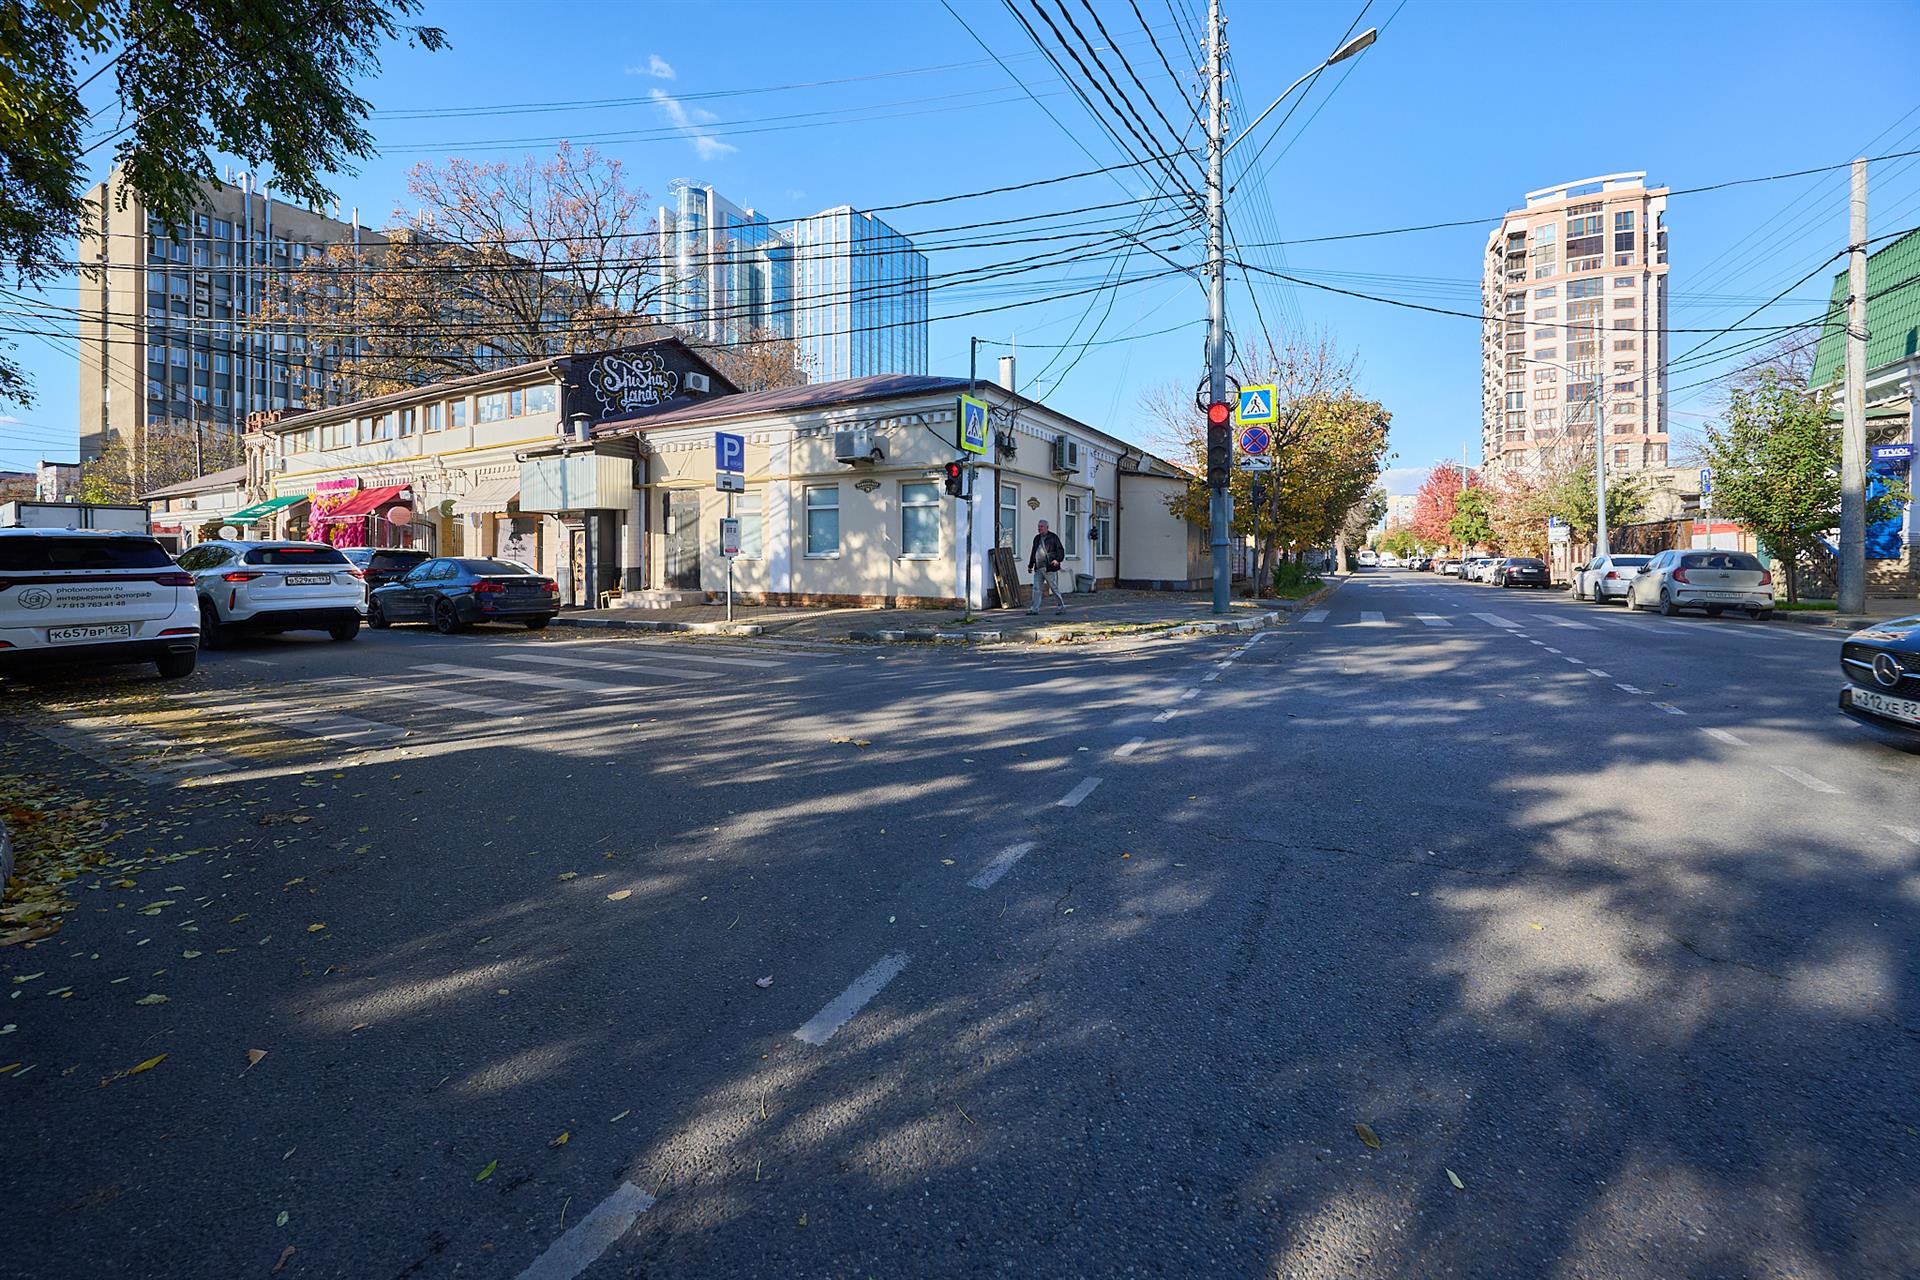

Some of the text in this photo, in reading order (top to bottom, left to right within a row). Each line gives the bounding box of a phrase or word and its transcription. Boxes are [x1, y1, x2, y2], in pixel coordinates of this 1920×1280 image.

[723, 437, 740, 467] P
[1877, 448, 1911, 457] STVOL
[56, 586, 124, 594] photomoiseev.ru
[56, 591, 152, 601] интерьерный фотограф
[54, 625, 128, 639] К657ВР 122
